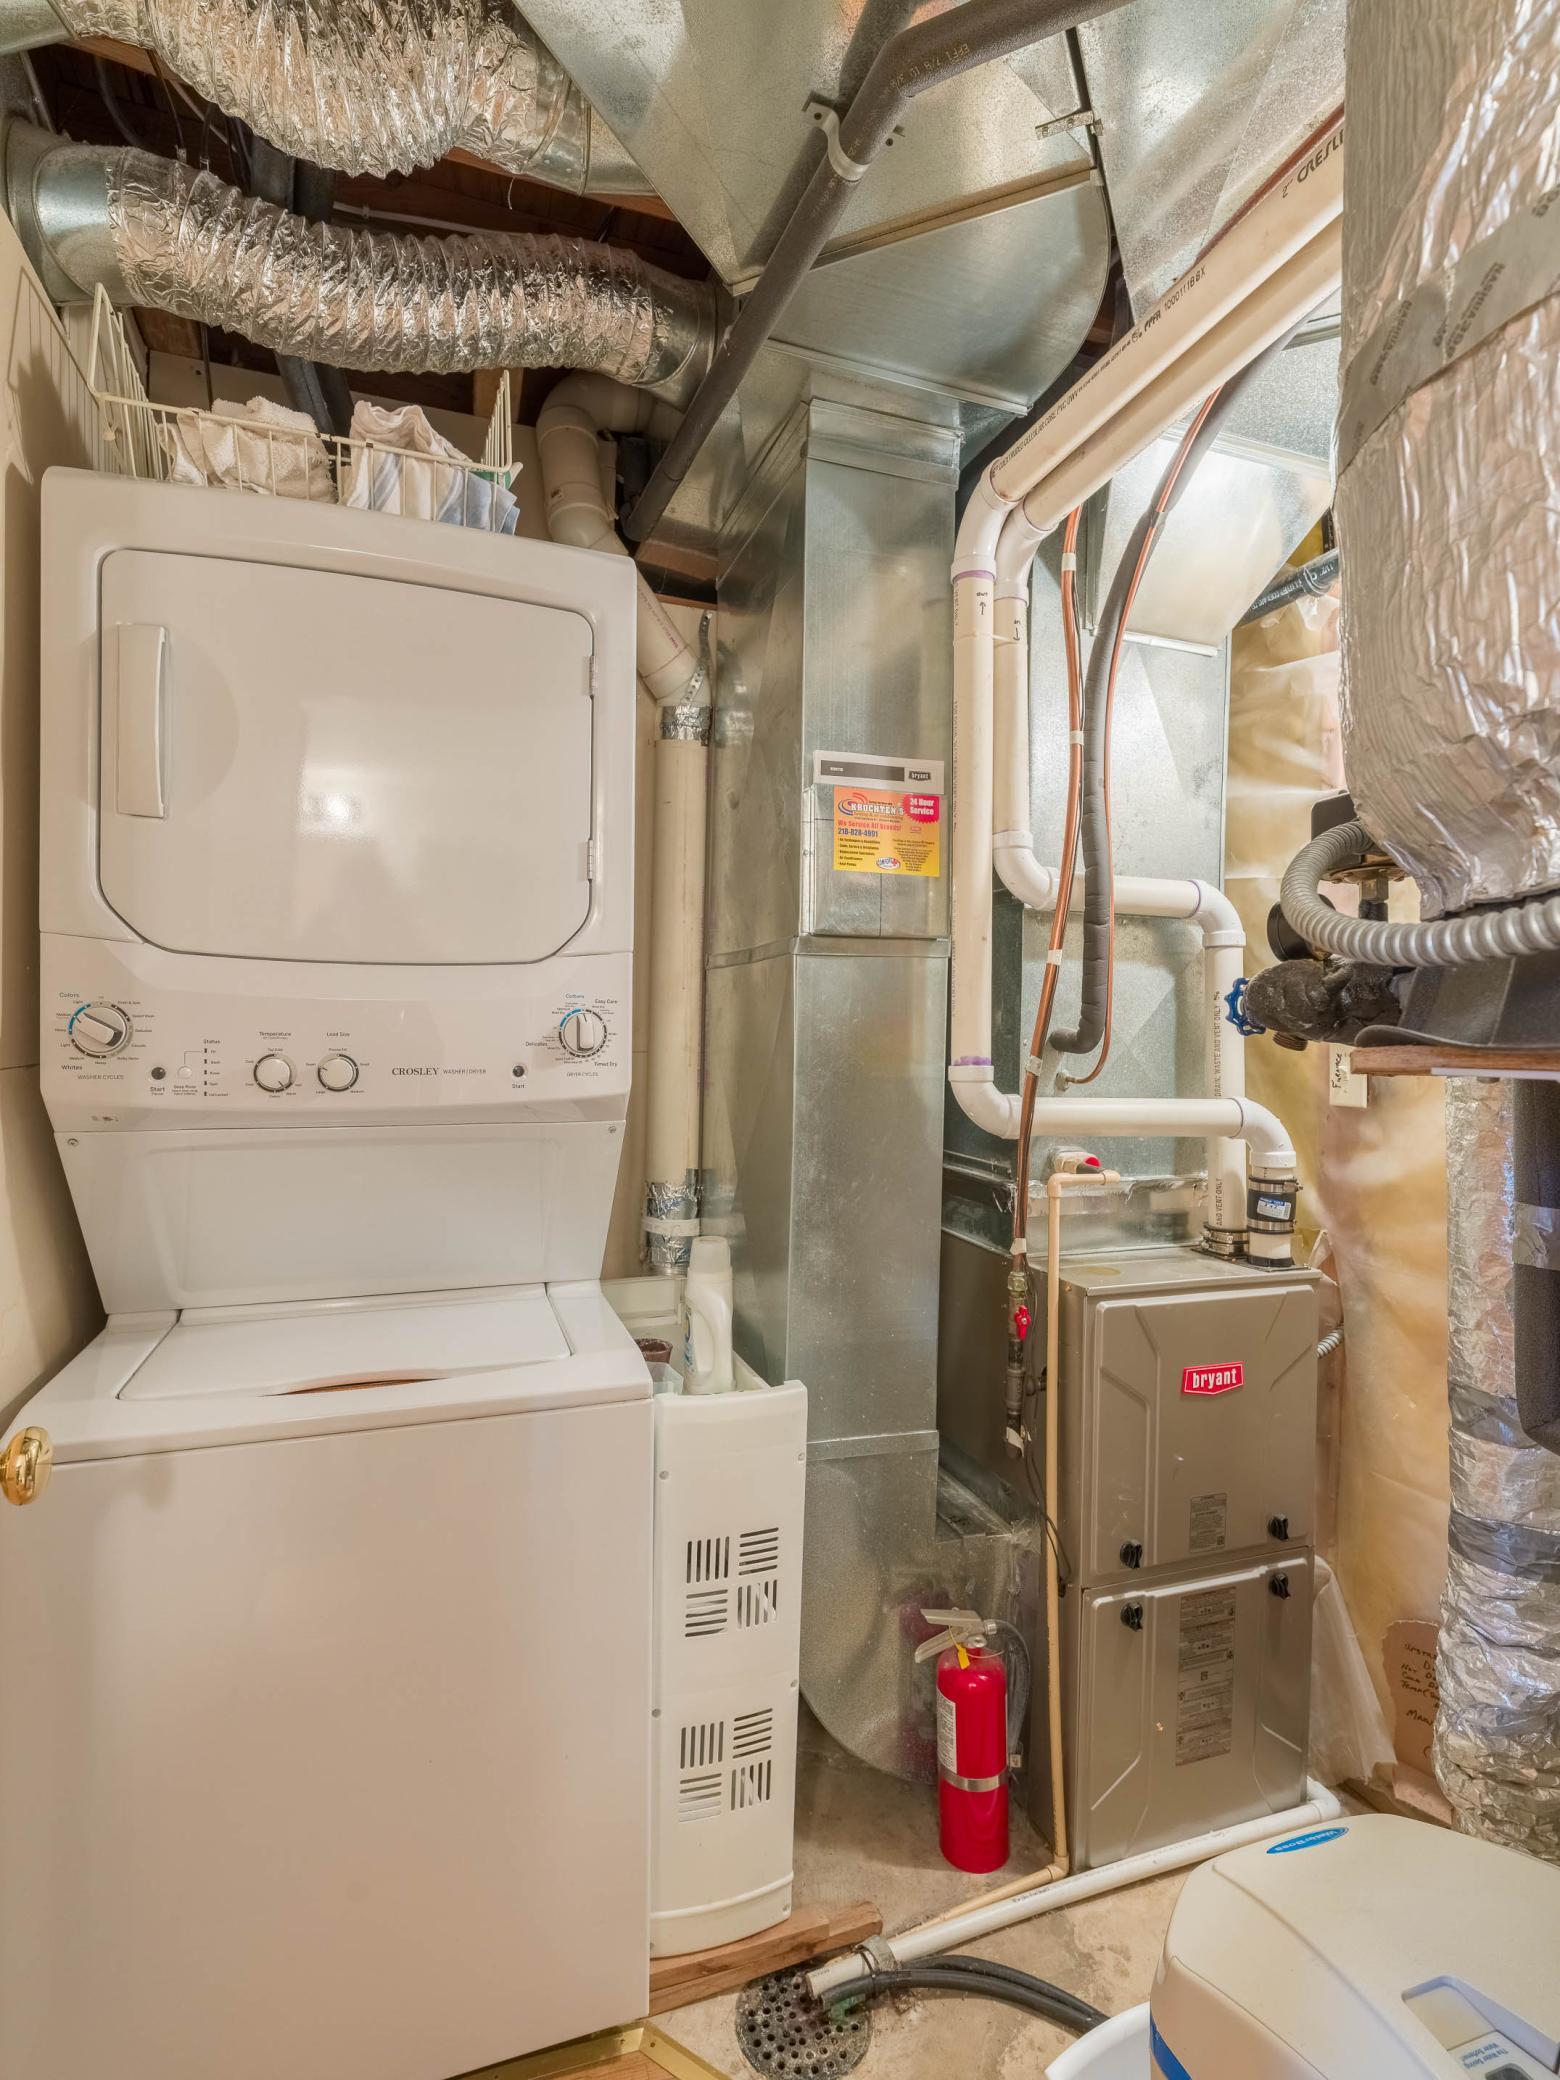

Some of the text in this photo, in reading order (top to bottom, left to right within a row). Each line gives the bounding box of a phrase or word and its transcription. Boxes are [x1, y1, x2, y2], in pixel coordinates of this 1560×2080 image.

[910, 806, 934, 816] Service
[1213, 1040, 1221, 1052] AND
[1213, 1054, 1221, 1074] WASTE
[392, 1067, 440, 1076] CROSLEY
[1192, 1368, 1237, 1389] bryant
